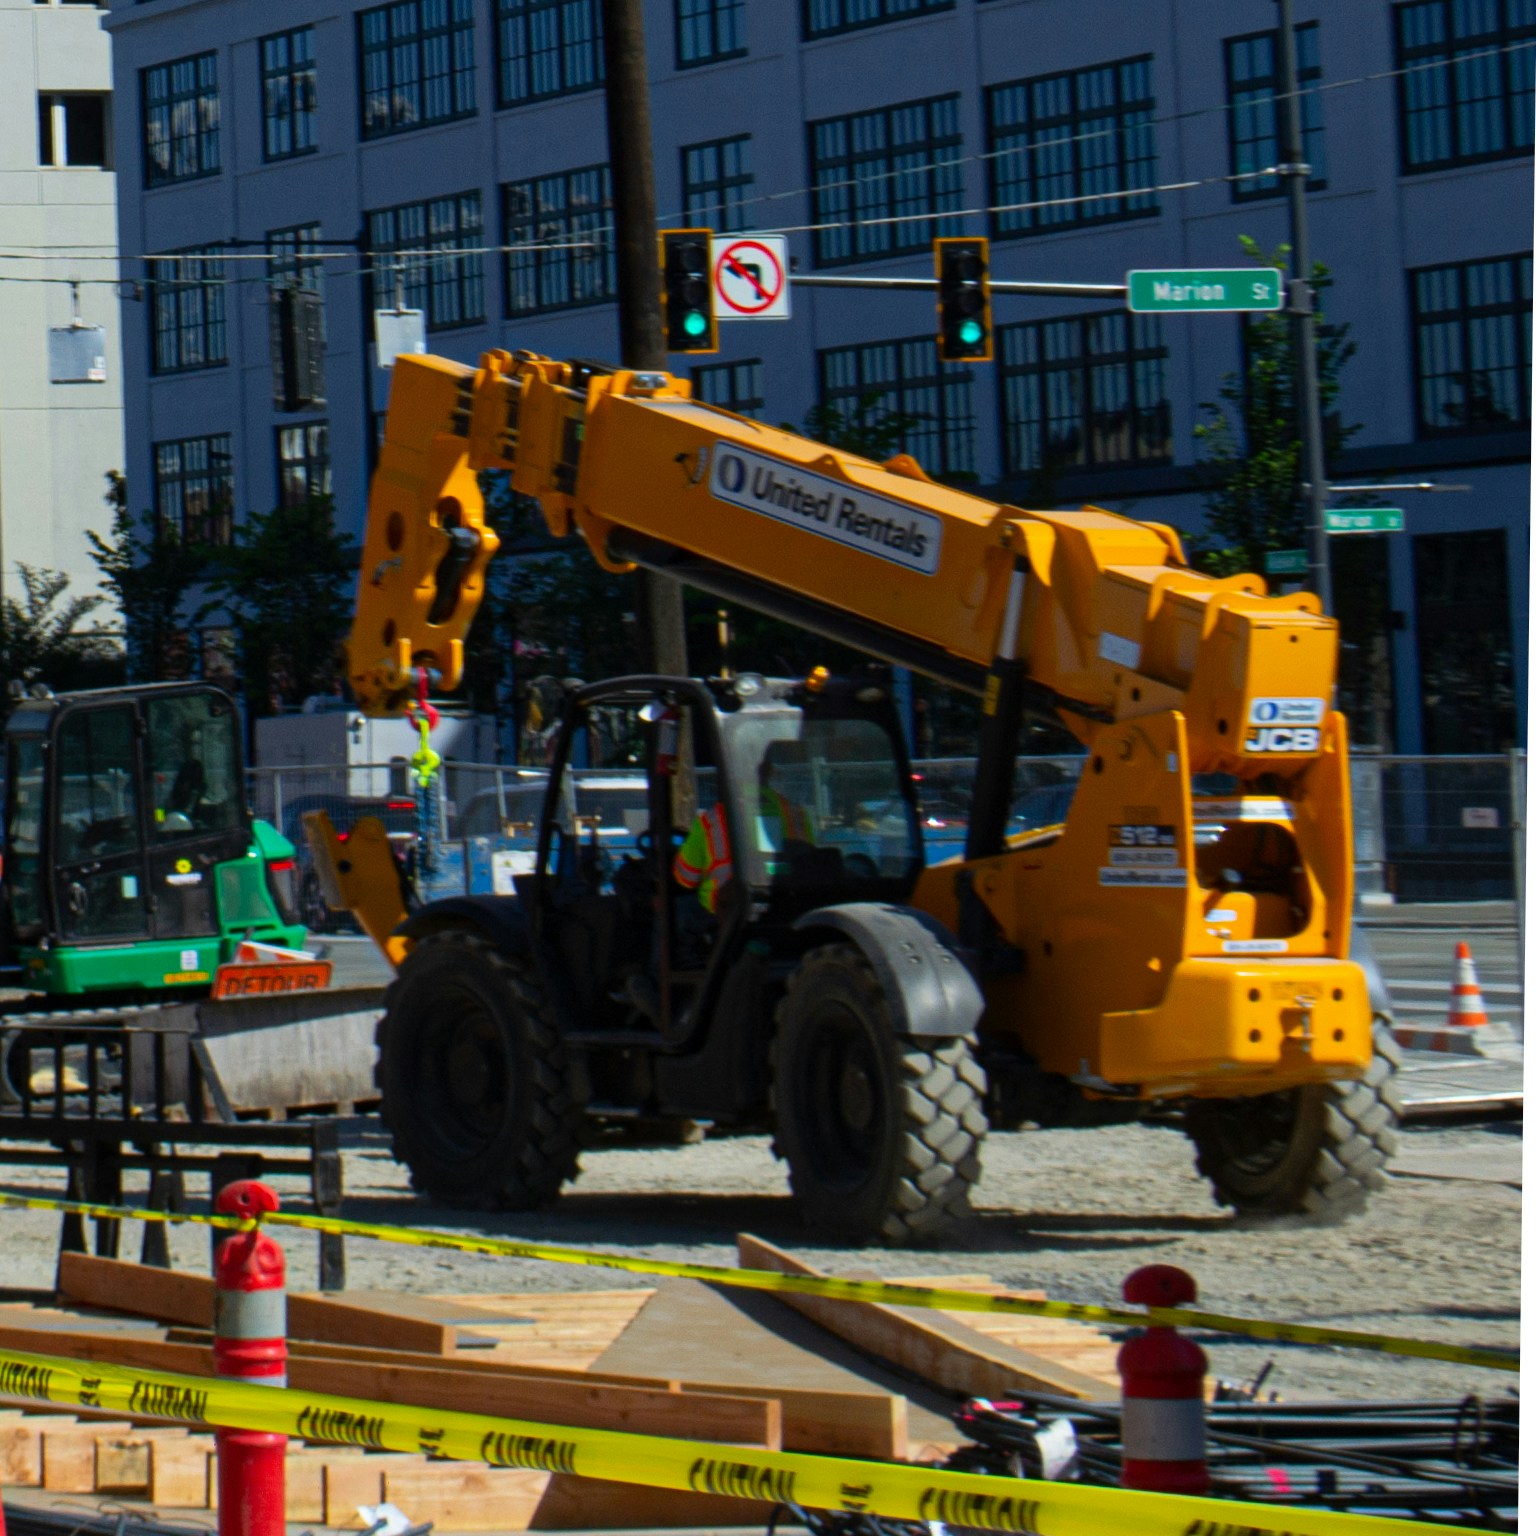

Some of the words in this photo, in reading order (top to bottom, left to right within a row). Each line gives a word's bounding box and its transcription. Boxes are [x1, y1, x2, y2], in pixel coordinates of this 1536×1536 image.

[1153, 280, 1225, 302] Marion
[1250, 282, 1271, 301] St
[752, 466, 833, 523] United
[835, 497, 928, 558] Rentals
[1246, 728, 1318, 751] JCB
[225, 974, 318, 996] DETOUR
